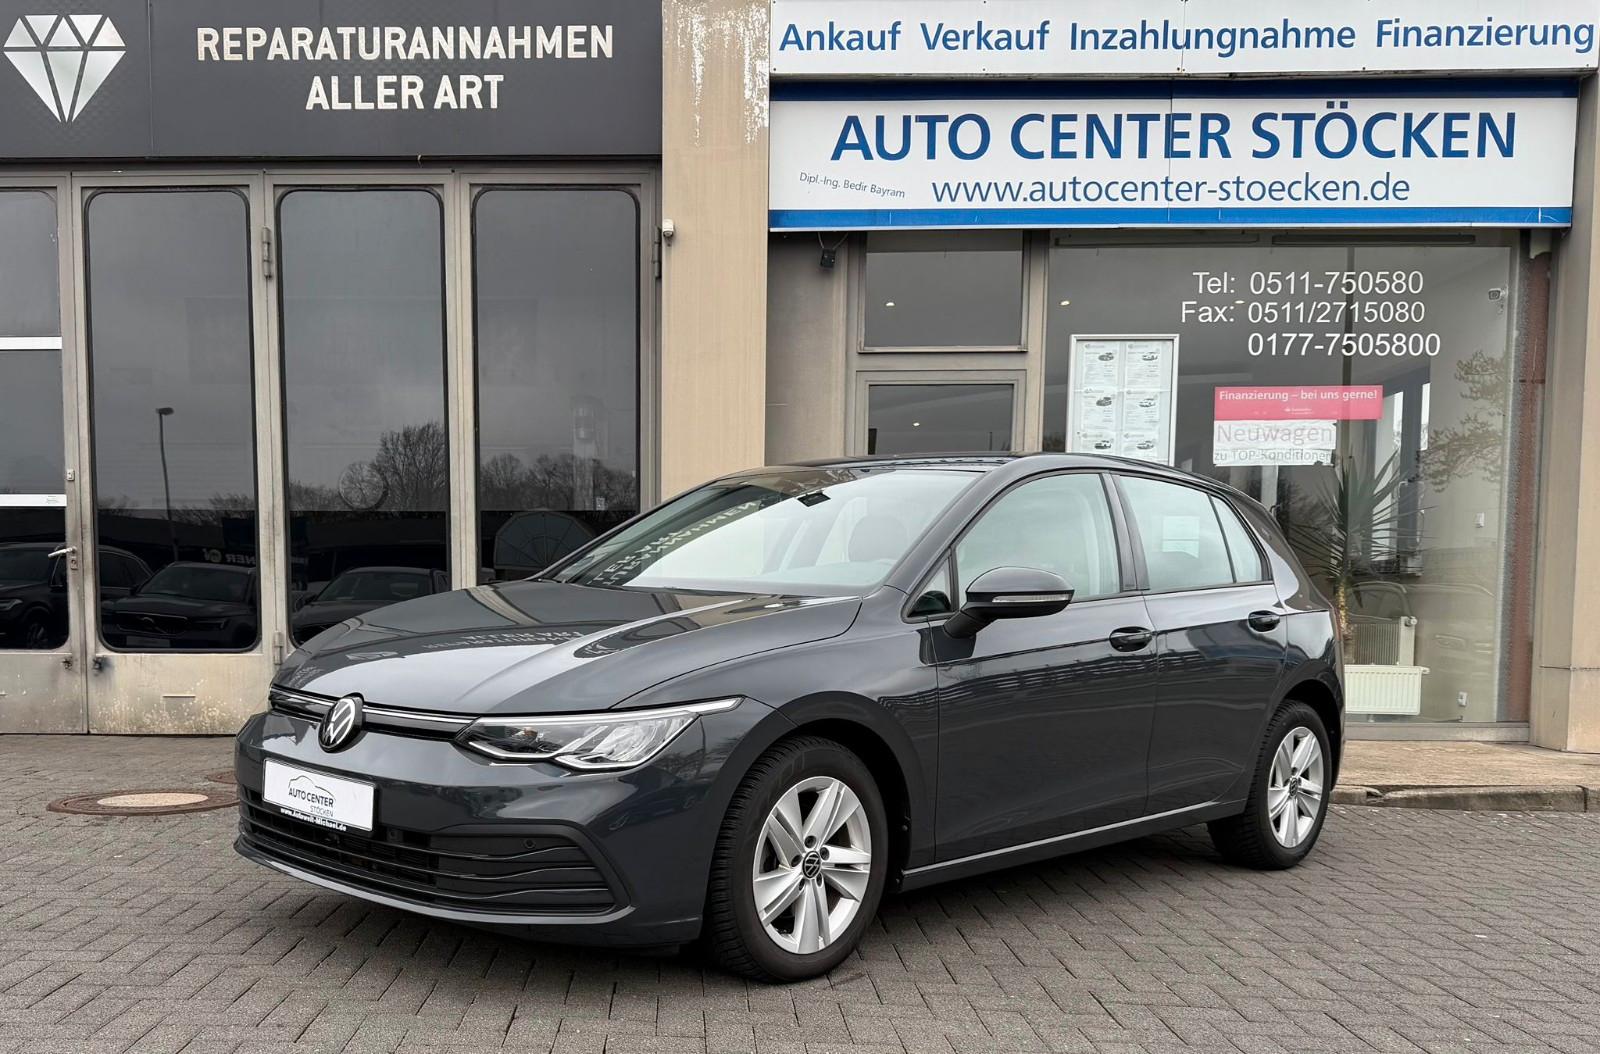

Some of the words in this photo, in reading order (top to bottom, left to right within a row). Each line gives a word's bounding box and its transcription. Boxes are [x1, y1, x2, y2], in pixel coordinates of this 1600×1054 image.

[196, 24, 613, 62] REPARATURANNAHMEN
[779, 20, 902, 51] Ankauf
[920, 20, 1050, 51] Verkauf
[1070, 19, 1356, 58] Inzahlungnahme
[1376, 17, 1594, 54] Finanzierung
[305, 74, 425, 111] ALLER
[433, 74, 505, 110] ART
[830, 113, 991, 161] AUTO
[1010, 113, 1232, 160] CENTER
[1251, 101, 1516, 160] STÖCKEN
[799, 172, 841, 189] Dipl.-Ing.
[843, 179, 868, 192] Bedir
[870, 184, 906, 199] Bayram
[931, 172, 1410, 203] www.autocenter-stoecken.de
[1192, 271, 1236, 294] Tel:
[1249, 270, 1425, 295] 0511-750580
[1180, 300, 1235, 323] Fax:
[1247, 300, 1426, 324] 0511/2715080
[1247, 332, 1441, 356] 0177-7505800
[1219, 391, 1289, 402] Finanzierung
[1301, 390, 1317, 400] bei
[1320, 391, 1340, 400] uns
[1343, 390, 1377, 402] gerne!
[1217, 424, 1332, 446] Neuwagen
[1214, 452, 1227, 461] zu
